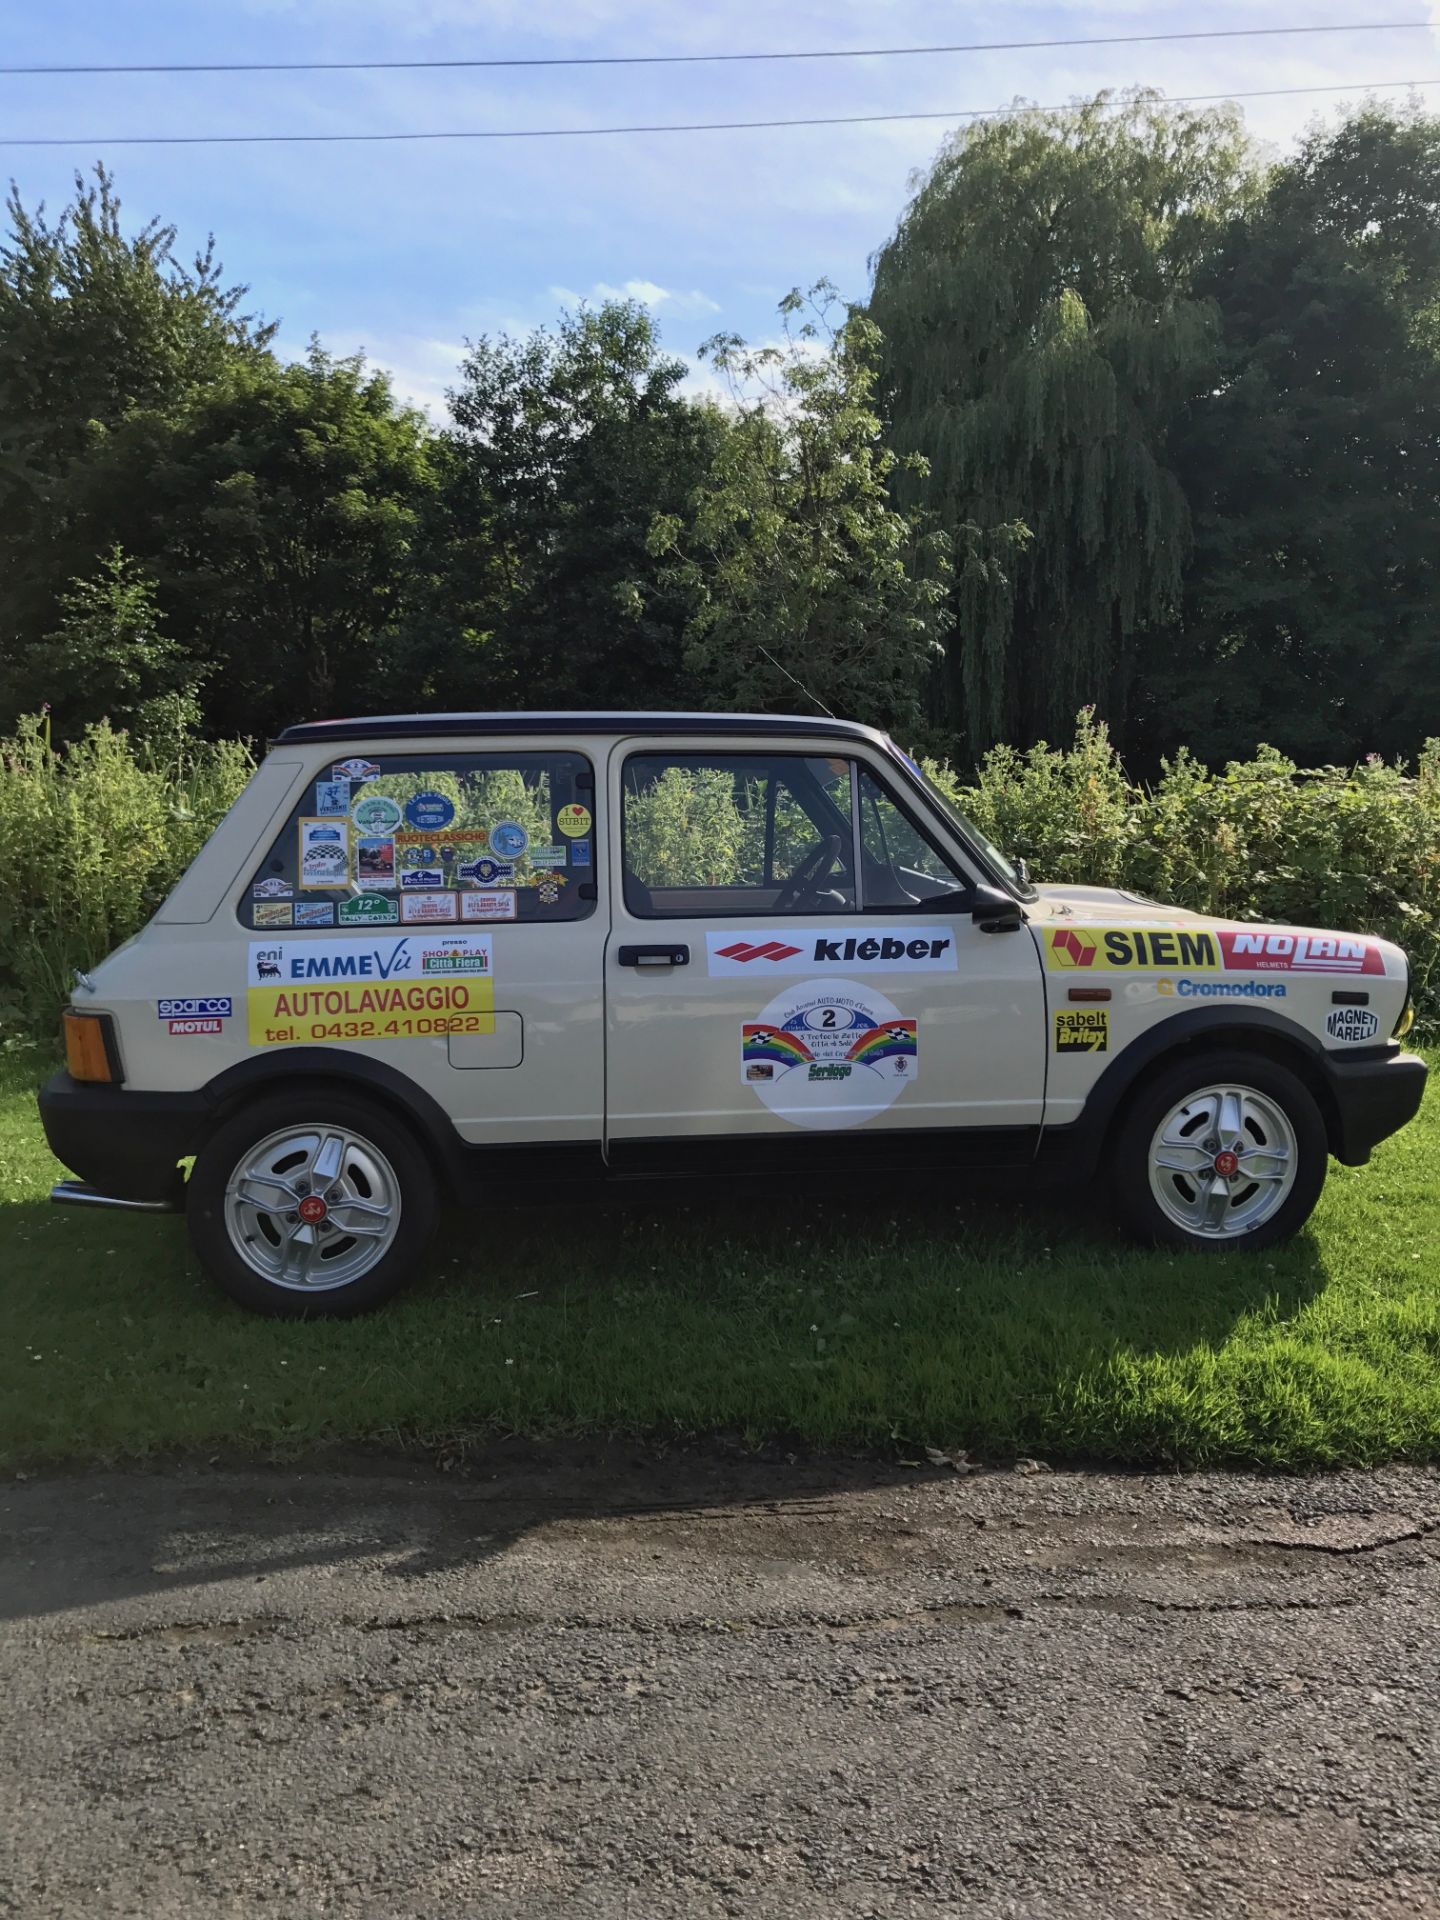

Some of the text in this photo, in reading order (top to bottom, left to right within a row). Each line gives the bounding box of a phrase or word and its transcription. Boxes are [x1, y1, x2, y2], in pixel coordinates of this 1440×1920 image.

[564, 808, 569, 816] I
[559, 818, 589, 826] SUBIT
[358, 899, 380, 910] 12°
[256, 946, 283, 961] eni
[422, 950, 449, 958] SHOP
[813, 937, 950, 961] kléber
[1103, 931, 1216, 966] SIEM
[1232, 934, 1367, 967] NOLAN
[429, 957, 480, 968] Città Fiera
[1256, 961, 1289, 969] HELMETS
[1177, 979, 1287, 997] Cromodora
[159, 998, 230, 1016] sparco
[274, 985, 469, 1018] AUTOLAVAGGIO
[171, 1020, 220, 1033] MOTUL
[822, 1009, 836, 1028] 2
[1056, 1012, 1107, 1027] sabelt
[265, 1016, 480, 1041] tel. 0432.410822
[1059, 1028, 1105, 1052] Britax
